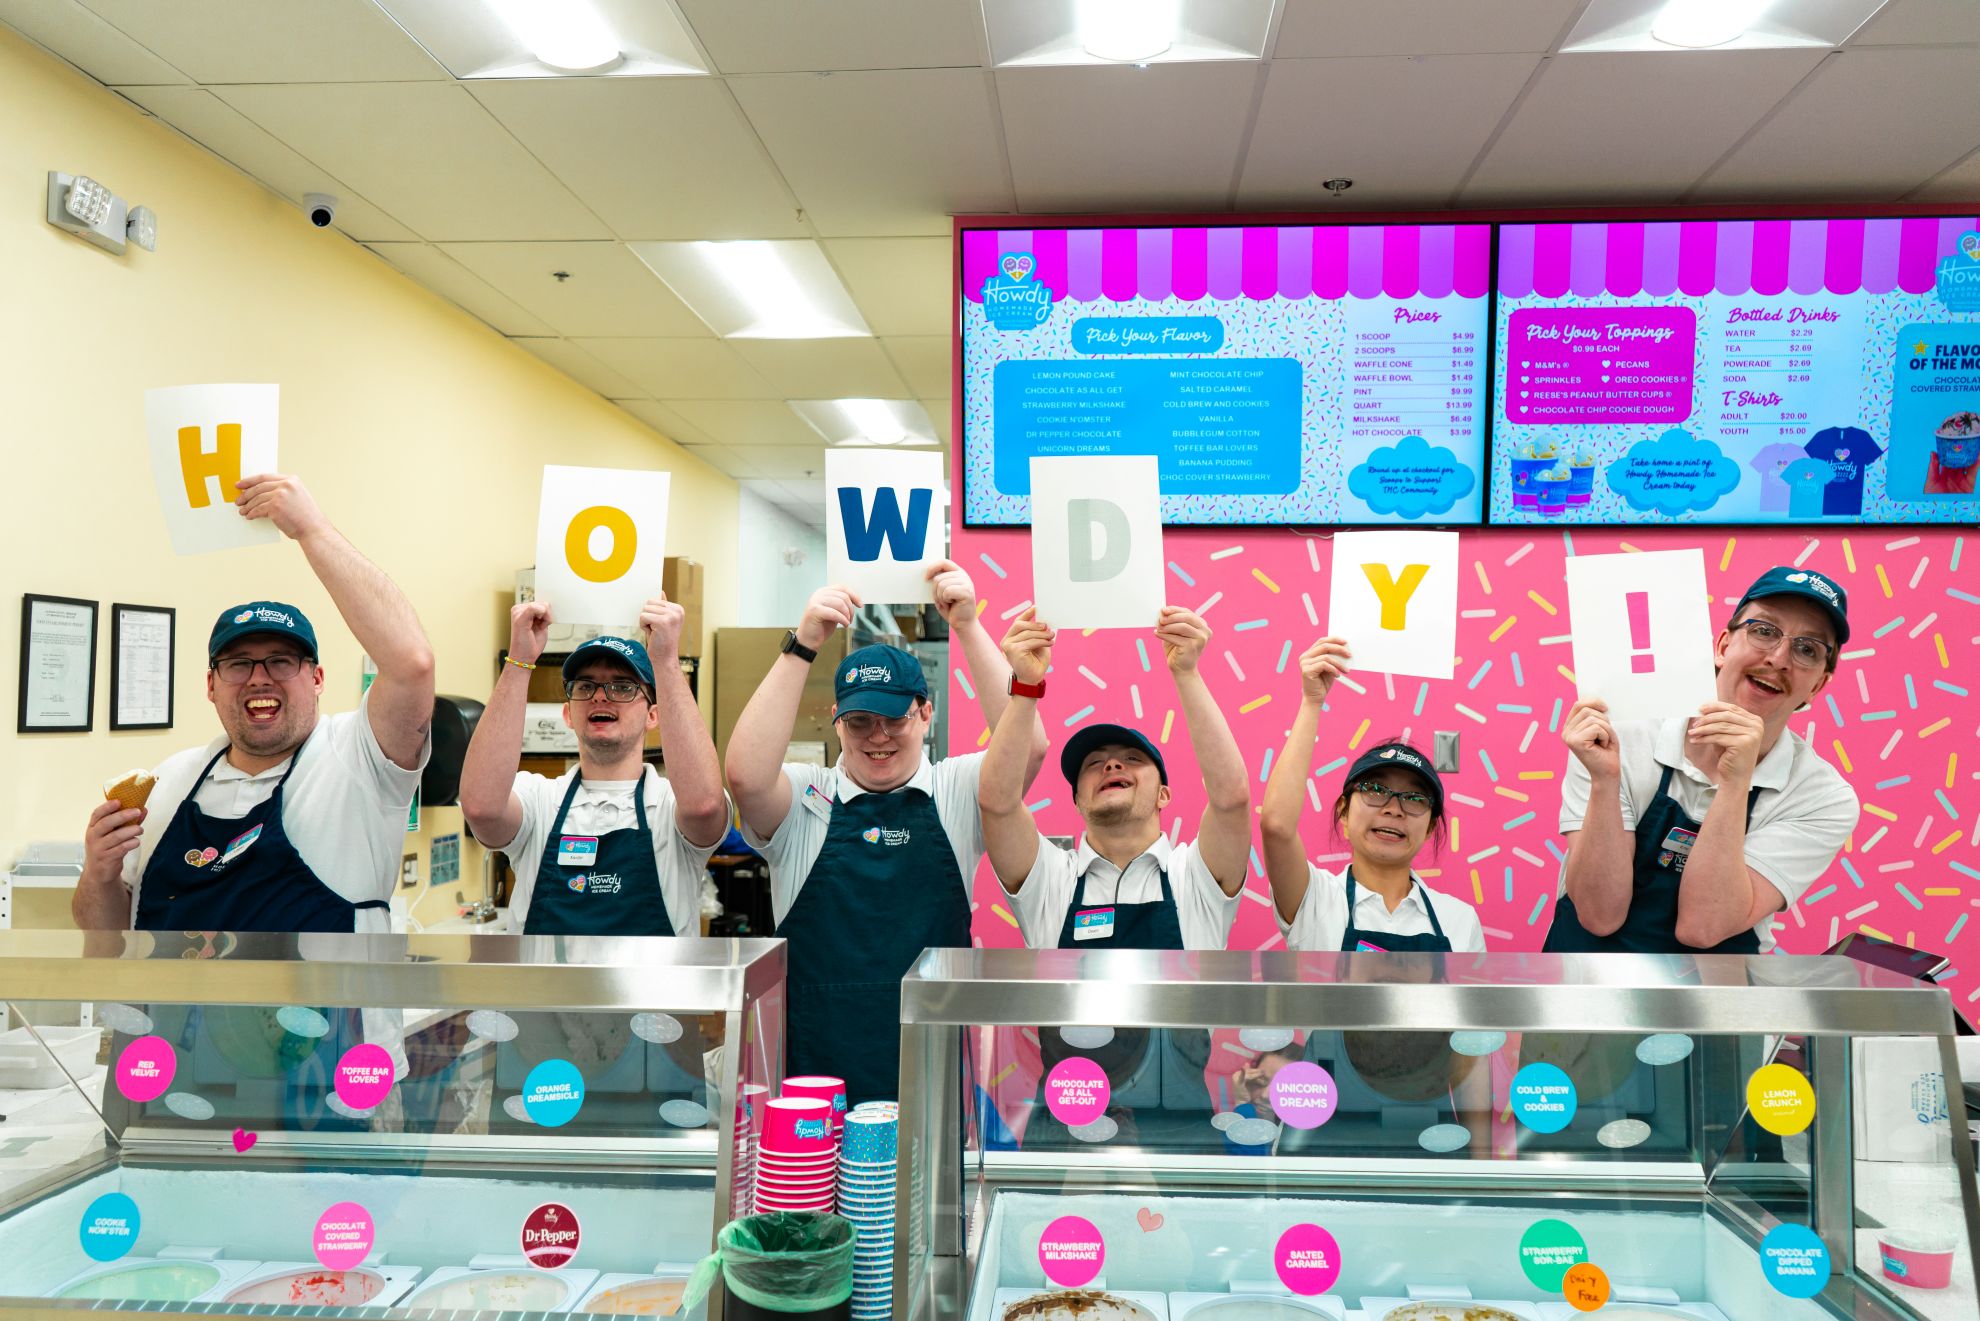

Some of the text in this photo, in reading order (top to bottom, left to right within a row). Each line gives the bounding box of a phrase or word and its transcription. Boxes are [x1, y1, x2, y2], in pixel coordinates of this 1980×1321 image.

[984, 280, 1050, 321] Howdy
[1394, 307, 1442, 323] Prices
[1726, 306, 1840, 323] Bottled Drinks
[1086, 327, 1212, 347] Pick Your Flavor
[1527, 323, 1674, 344] Pick Your Toppings
[1573, 345, 1594, 353] $0.99
[1452, 360, 1473, 368] $1.49
[1909, 358, 1957, 370] OF THE
[1722, 390, 1783, 406] T-Shirts
[1534, 406, 1585, 414] CHOCOLATE
[1587, 406, 1606, 414] CHIP
[178, 423, 242, 508] H
[1631, 458, 1700, 467] Take home pint
[1368, 466, 1390, 474] Round
[1625, 470, 1716, 479] Howdy Homemade Ice
[1414, 476, 1442, 484] Support
[1400, 486, 1438, 495] Community
[1643, 482, 1696, 492] Cream today
[837, 487, 933, 562] W
[564, 506, 637, 583] O
[1068, 498, 1131, 582] D
[1360, 563, 1430, 631] Y
[254, 607, 294, 627] Howdy
[1626, 592, 1655, 673] !
[859, 664, 891, 682] Howdy
[881, 826, 910, 844] Howdy
[587, 872, 621, 893] Howdy
[138, 1060, 155, 1068] RED
[130, 1068, 160, 1077] VELVET
[342, 1067, 370, 1075] TOFFEE
[1052, 1080, 1104, 1088] CHOCOLATE
[1276, 1083, 1328, 1094] UNICORN
[536, 1084, 570, 1094] ORANGE
[1517, 1086, 1569, 1094] COLD BREW
[528, 1091, 579, 1103] DREAMSICLE
[1764, 1090, 1796, 1098] LEMON
[1058, 1097, 1096, 1105] GET-OUT
[1280, 1097, 1328, 1108] DREAMS
[1762, 1098, 1802, 1108] CRUNCH
[1524, 1103, 1565, 1111] COOKIES
[795, 1120, 824, 1138] Howdy
[95, 1218, 127, 1226] COOKIE
[321, 1222, 366, 1231] CHOCOLATE
[325, 1232, 360, 1240] COVERED
[526, 1229, 576, 1245] Dr Pepper
[318, 1242, 368, 1250] STRAWBERRY
[1042, 1242, 1101, 1251] STRAWBERRY
[1046, 1251, 1097, 1260] MILKSHAKE
[1290, 1250, 1324, 1259] SALTED
[1523, 1247, 1583, 1256] STRAWBERRY
[1766, 1248, 1822, 1257] CHOCOLATE
[1286, 1259, 1329, 1268] CARAMEL
[1778, 1257, 1812, 1266] DIPPED
[1777, 1266, 1816, 1275] BANANA
[1579, 1290, 1600, 1301] Free
